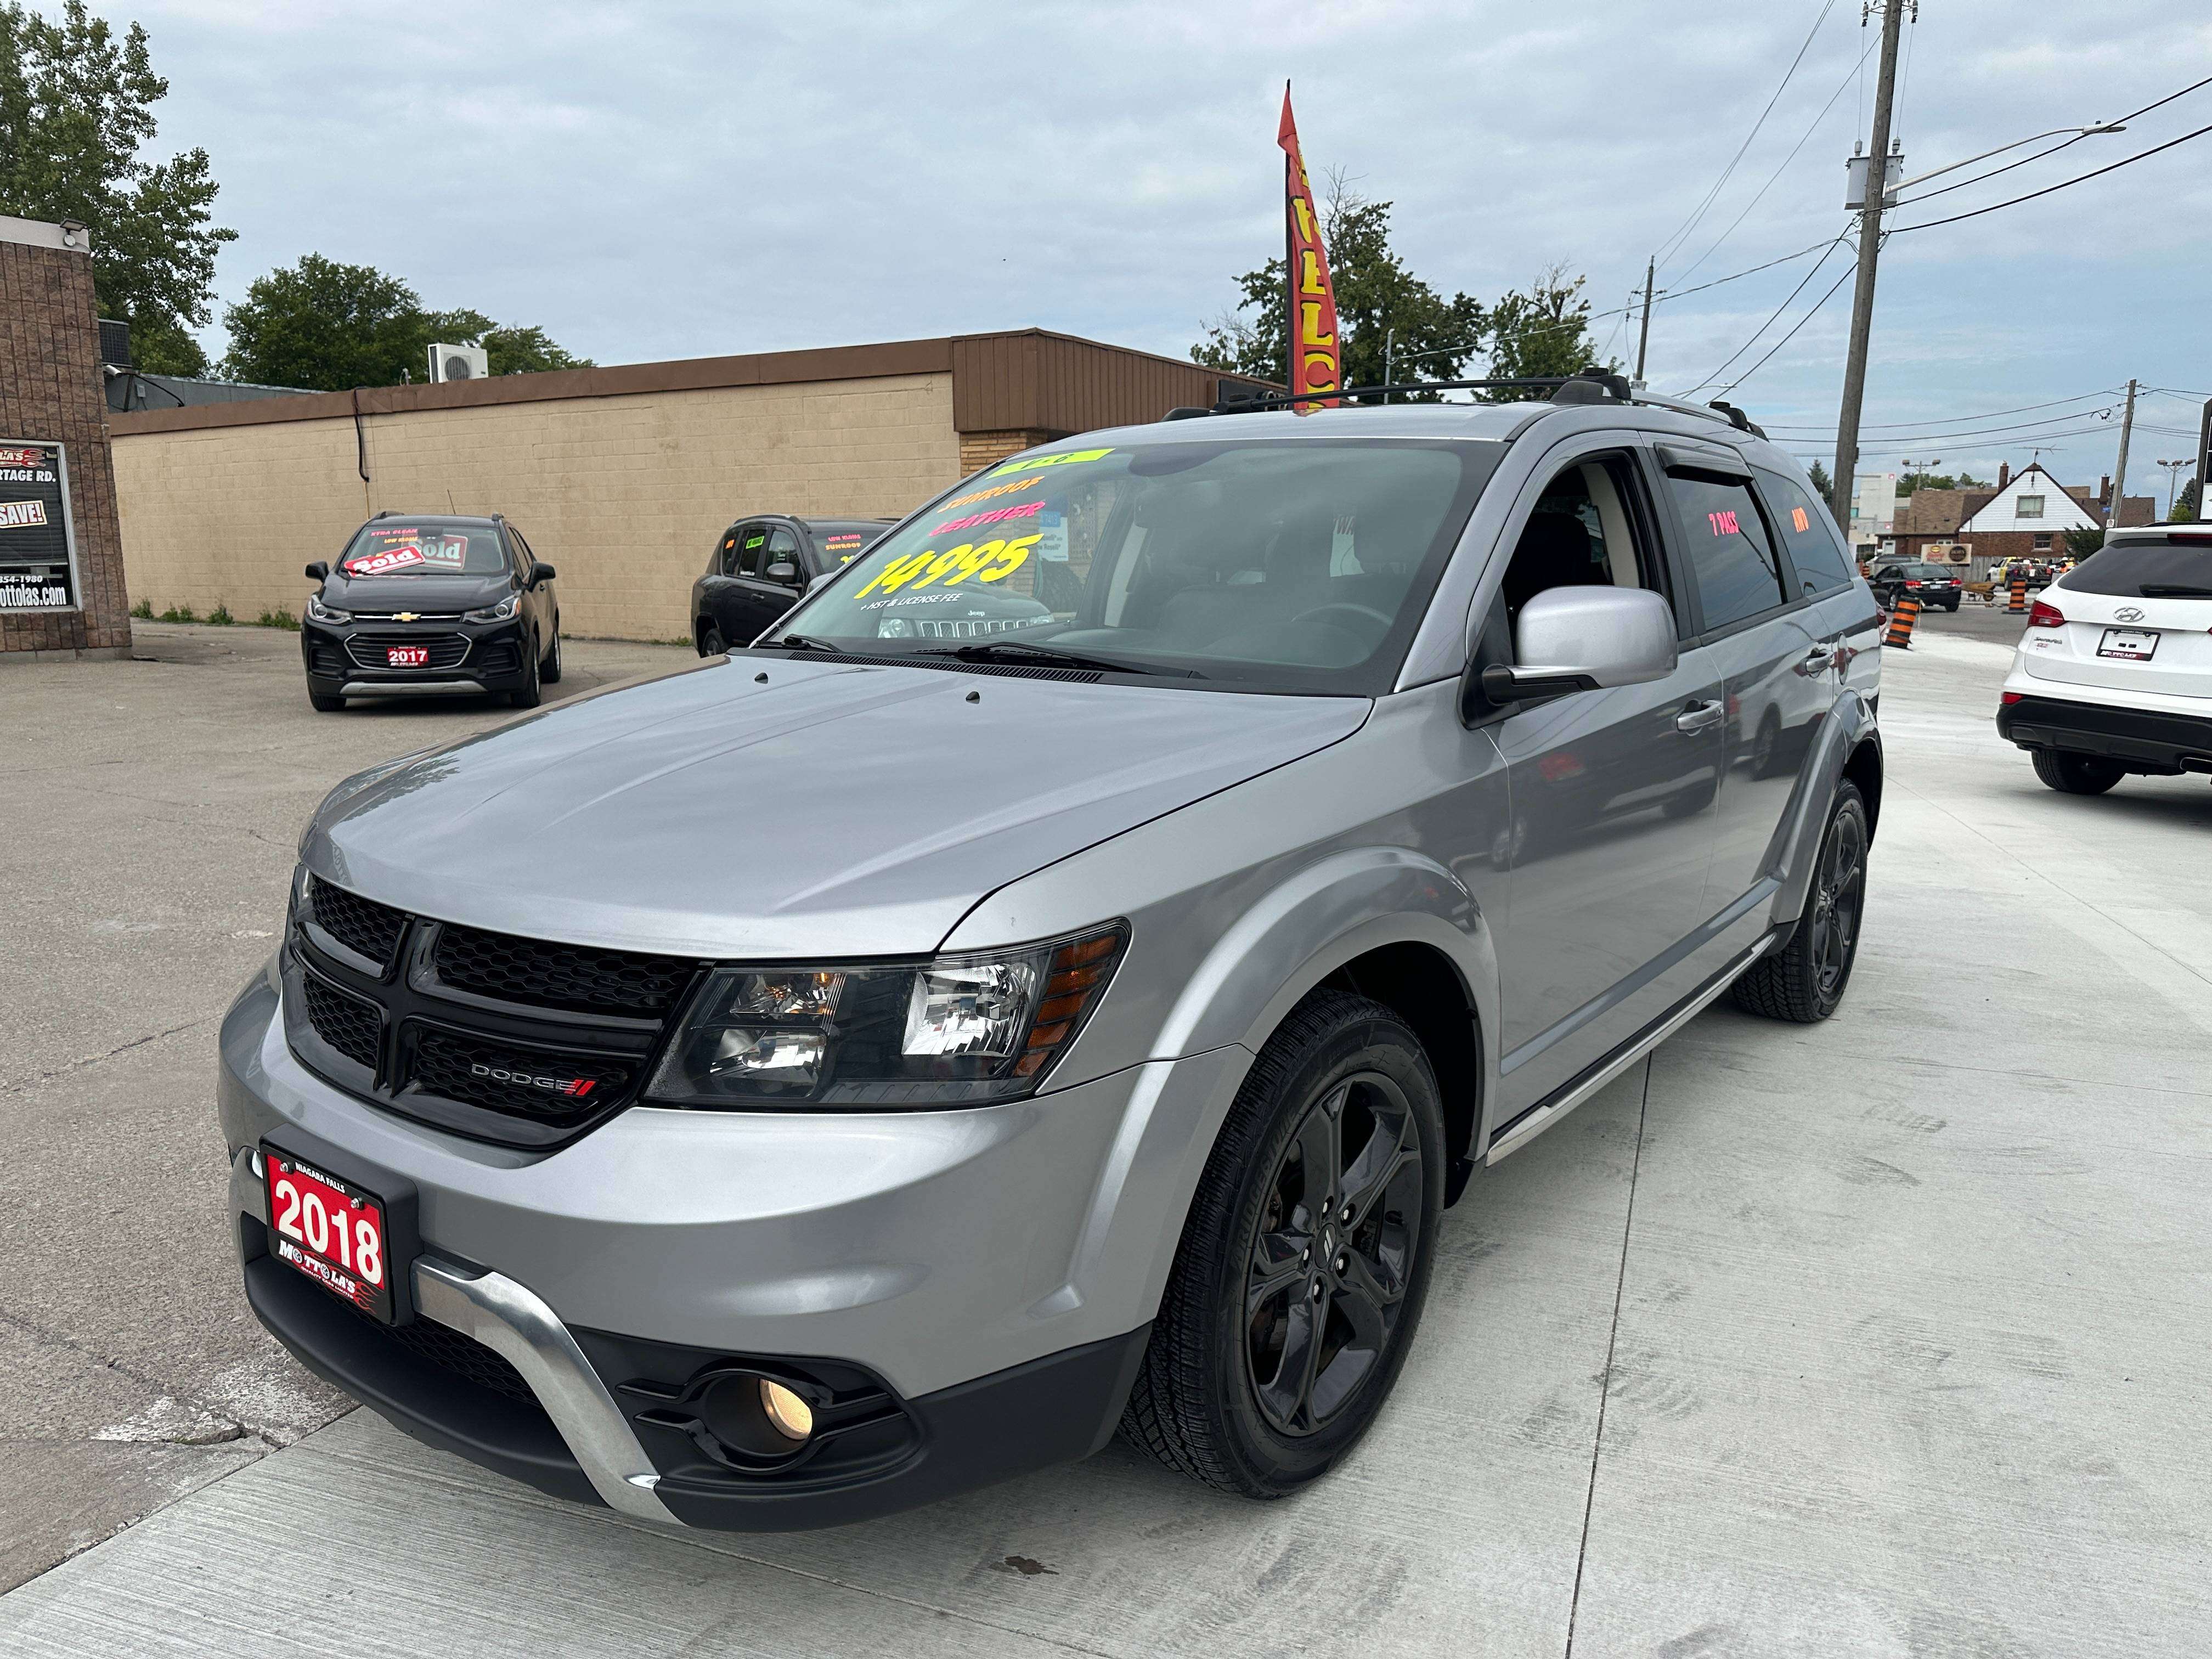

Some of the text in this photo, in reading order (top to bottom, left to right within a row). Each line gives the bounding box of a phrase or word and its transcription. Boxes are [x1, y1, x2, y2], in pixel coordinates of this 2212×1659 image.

[36, 470, 56, 482] RD.
[929, 500, 1045, 537] LEATHER
[1708, 513, 1718, 536] 7
[353, 550, 416, 572] Sold
[854, 533, 1045, 599] 14995
[897, 594, 943, 606] LICENSE
[939, 593, 964, 602] FEE
[388, 650, 427, 662] 2017
[471, 1064, 576, 1092] DODGE
[325, 1177, 346, 1194] FALLS
[275, 1179, 382, 1284] 2018
